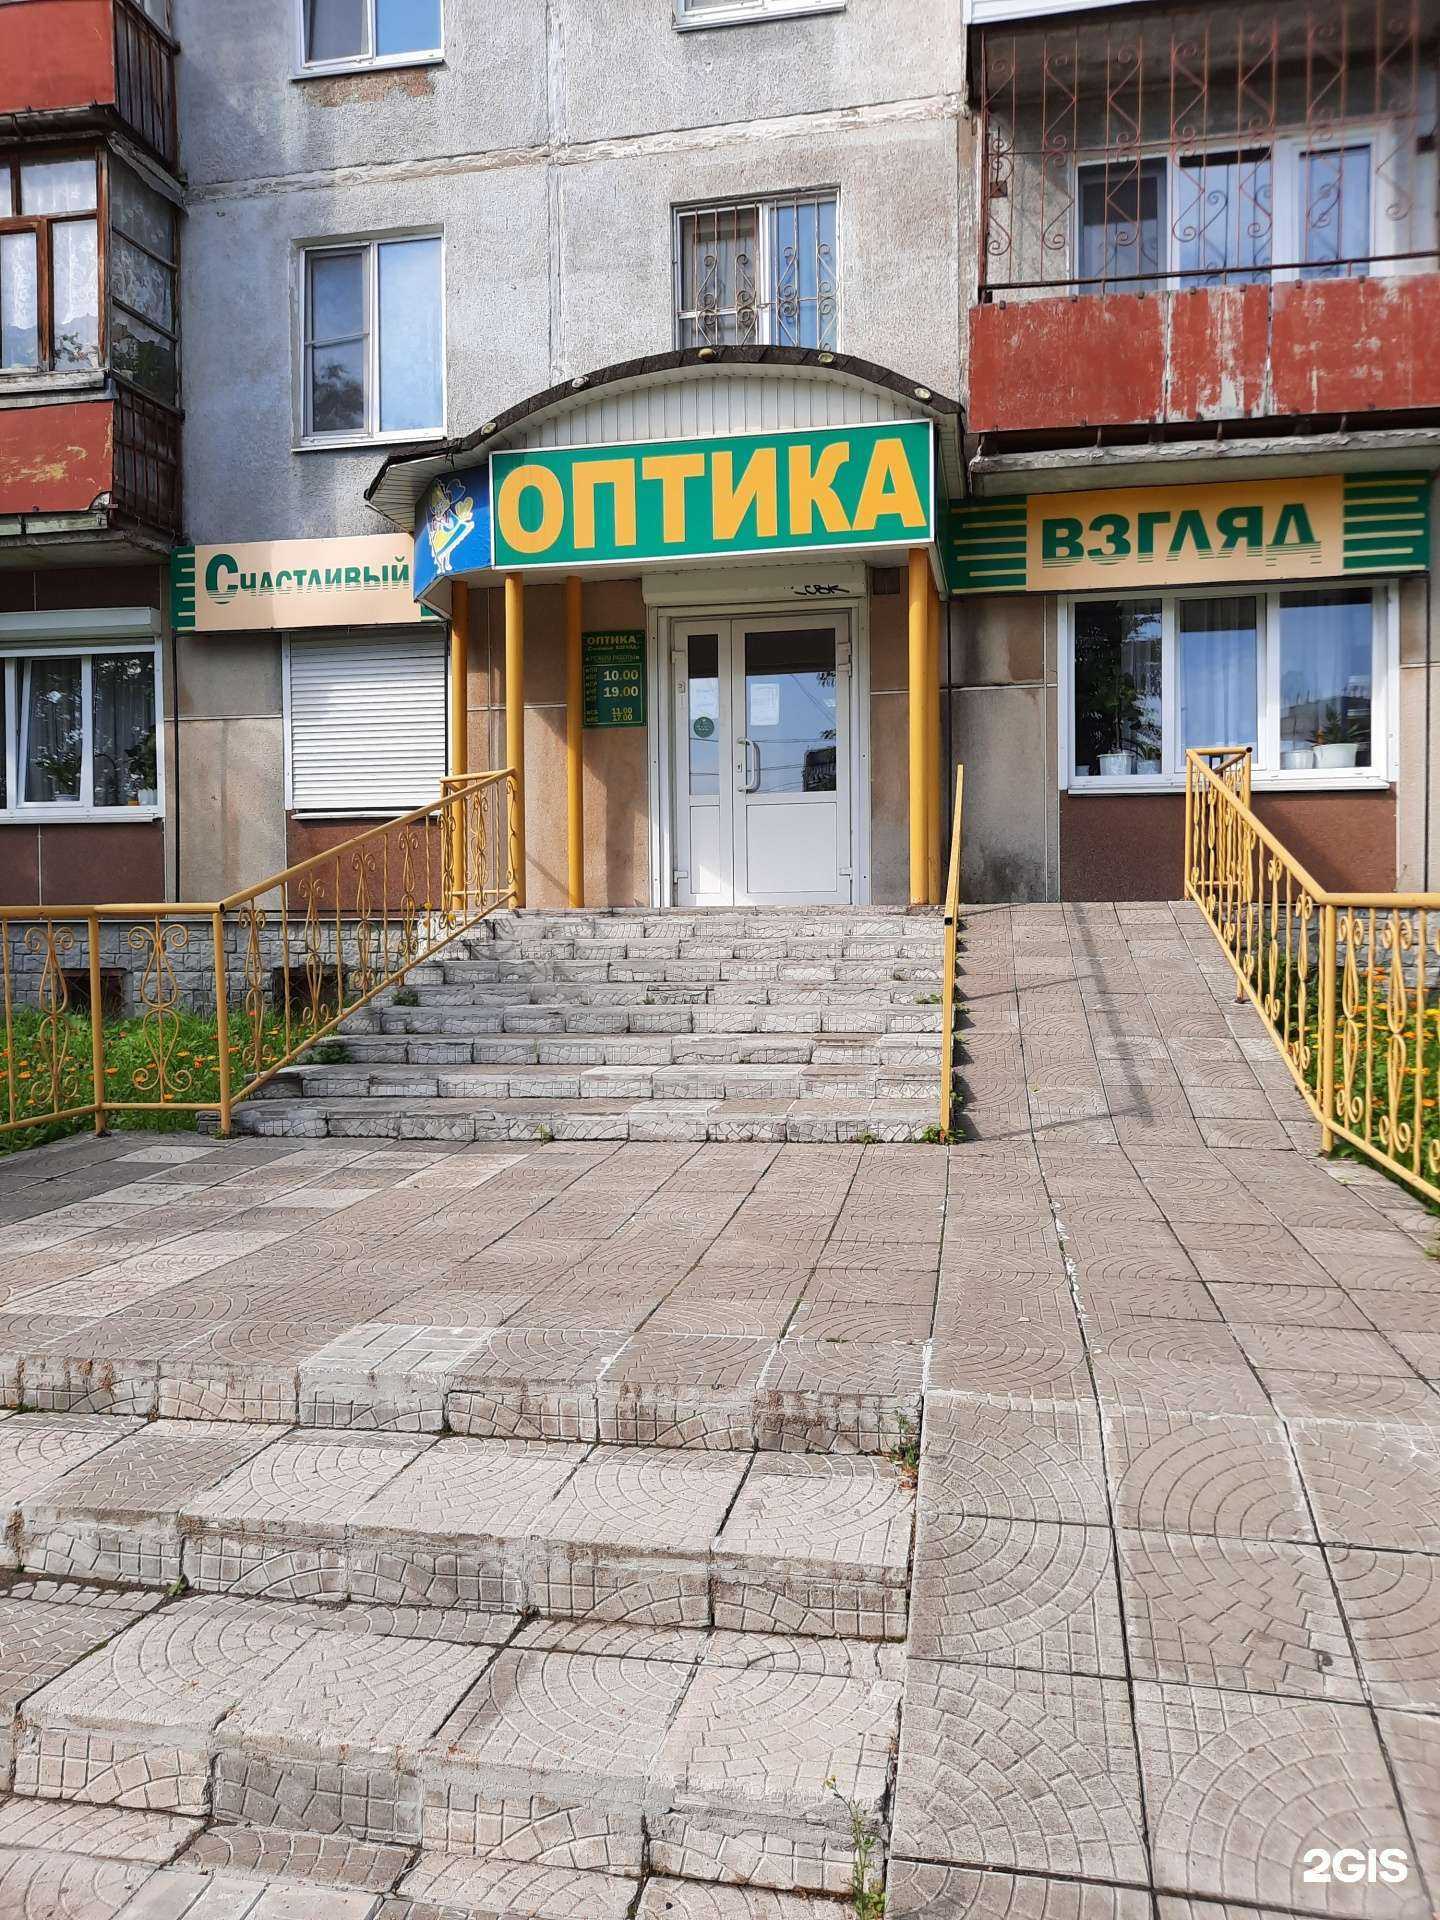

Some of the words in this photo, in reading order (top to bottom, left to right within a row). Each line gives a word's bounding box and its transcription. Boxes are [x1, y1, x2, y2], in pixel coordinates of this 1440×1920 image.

[498, 438, 927, 553] ОПТИКА
[1041, 503, 1322, 567] ВЗГЛЯД
[587, 635, 637, 646] ОПТИКА
[603, 670, 639, 681] 10.00
[603, 686, 639, 698] 19.00
